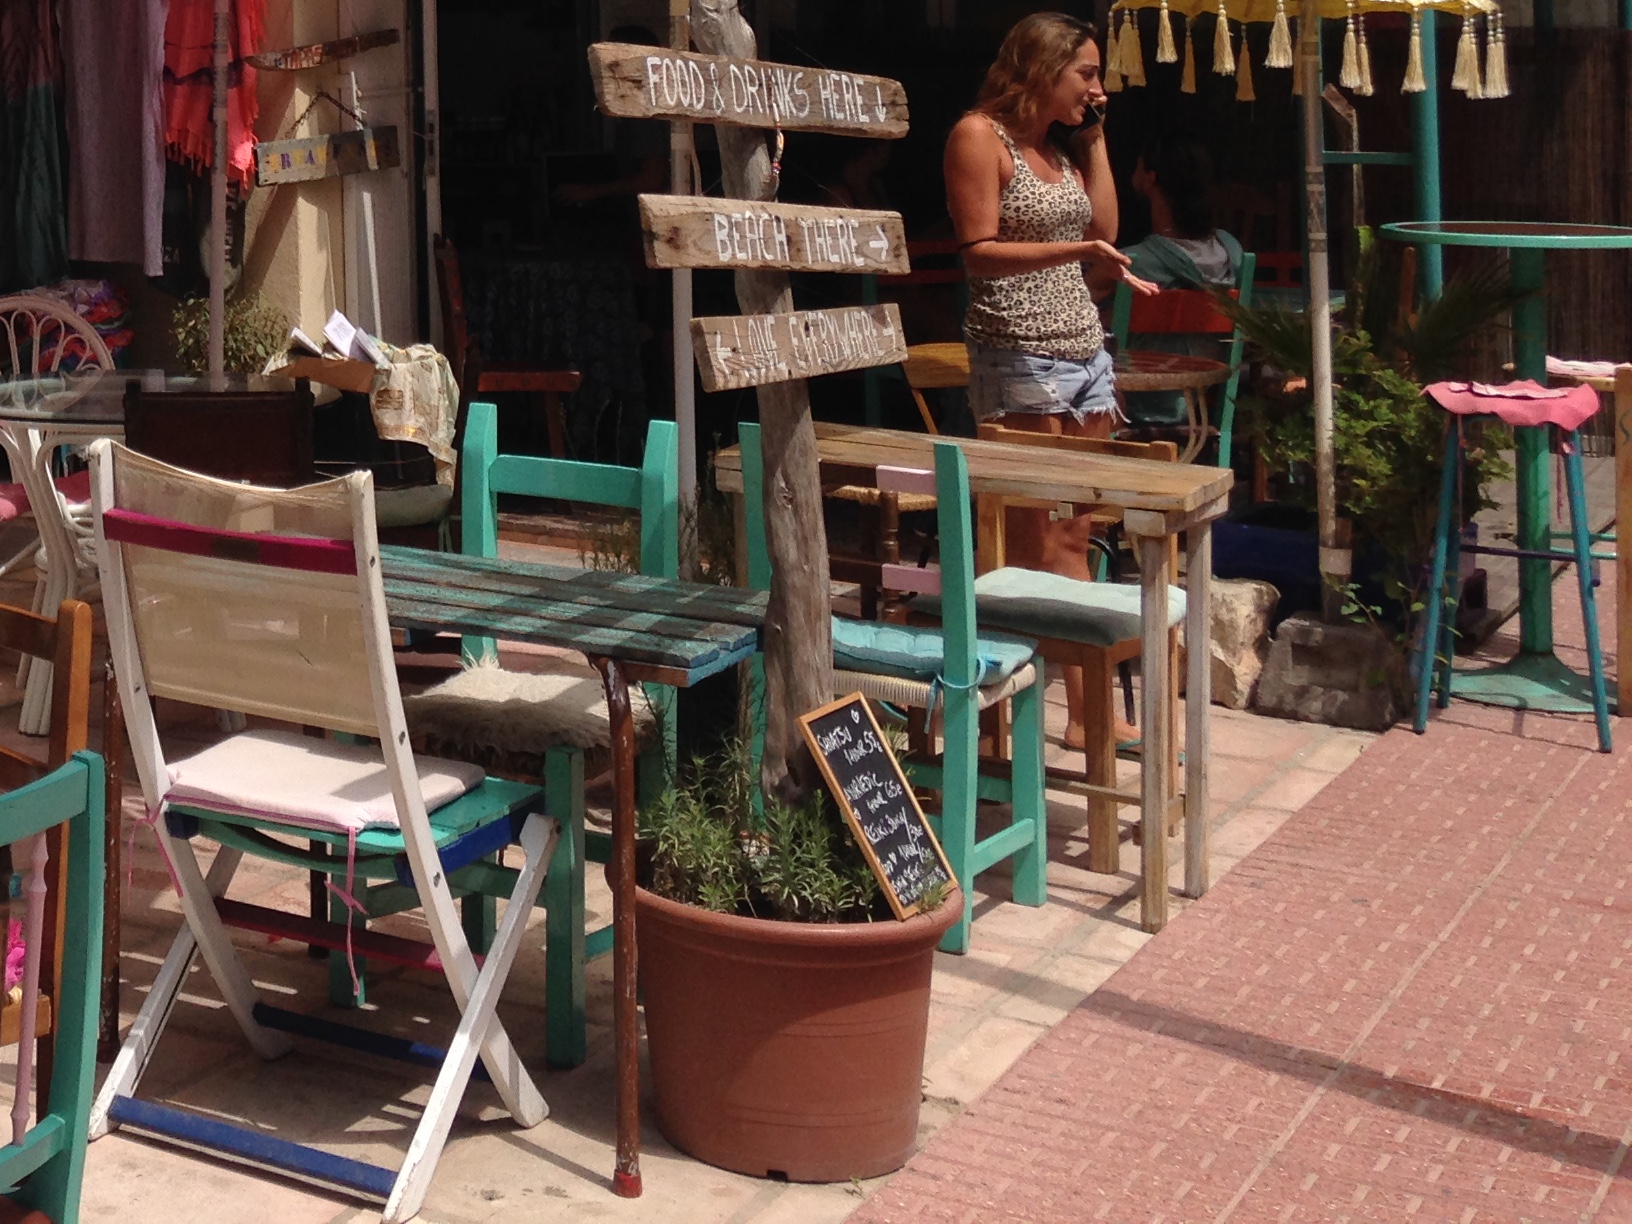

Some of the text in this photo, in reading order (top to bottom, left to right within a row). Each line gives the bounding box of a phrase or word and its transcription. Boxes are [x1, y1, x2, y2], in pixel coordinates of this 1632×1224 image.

[646, 56, 869, 123] FOOD & DRINKS HERE
[714, 210, 865, 267] BEACH THERE
[732, 310, 885, 379] LOVE EVERYWHERE
